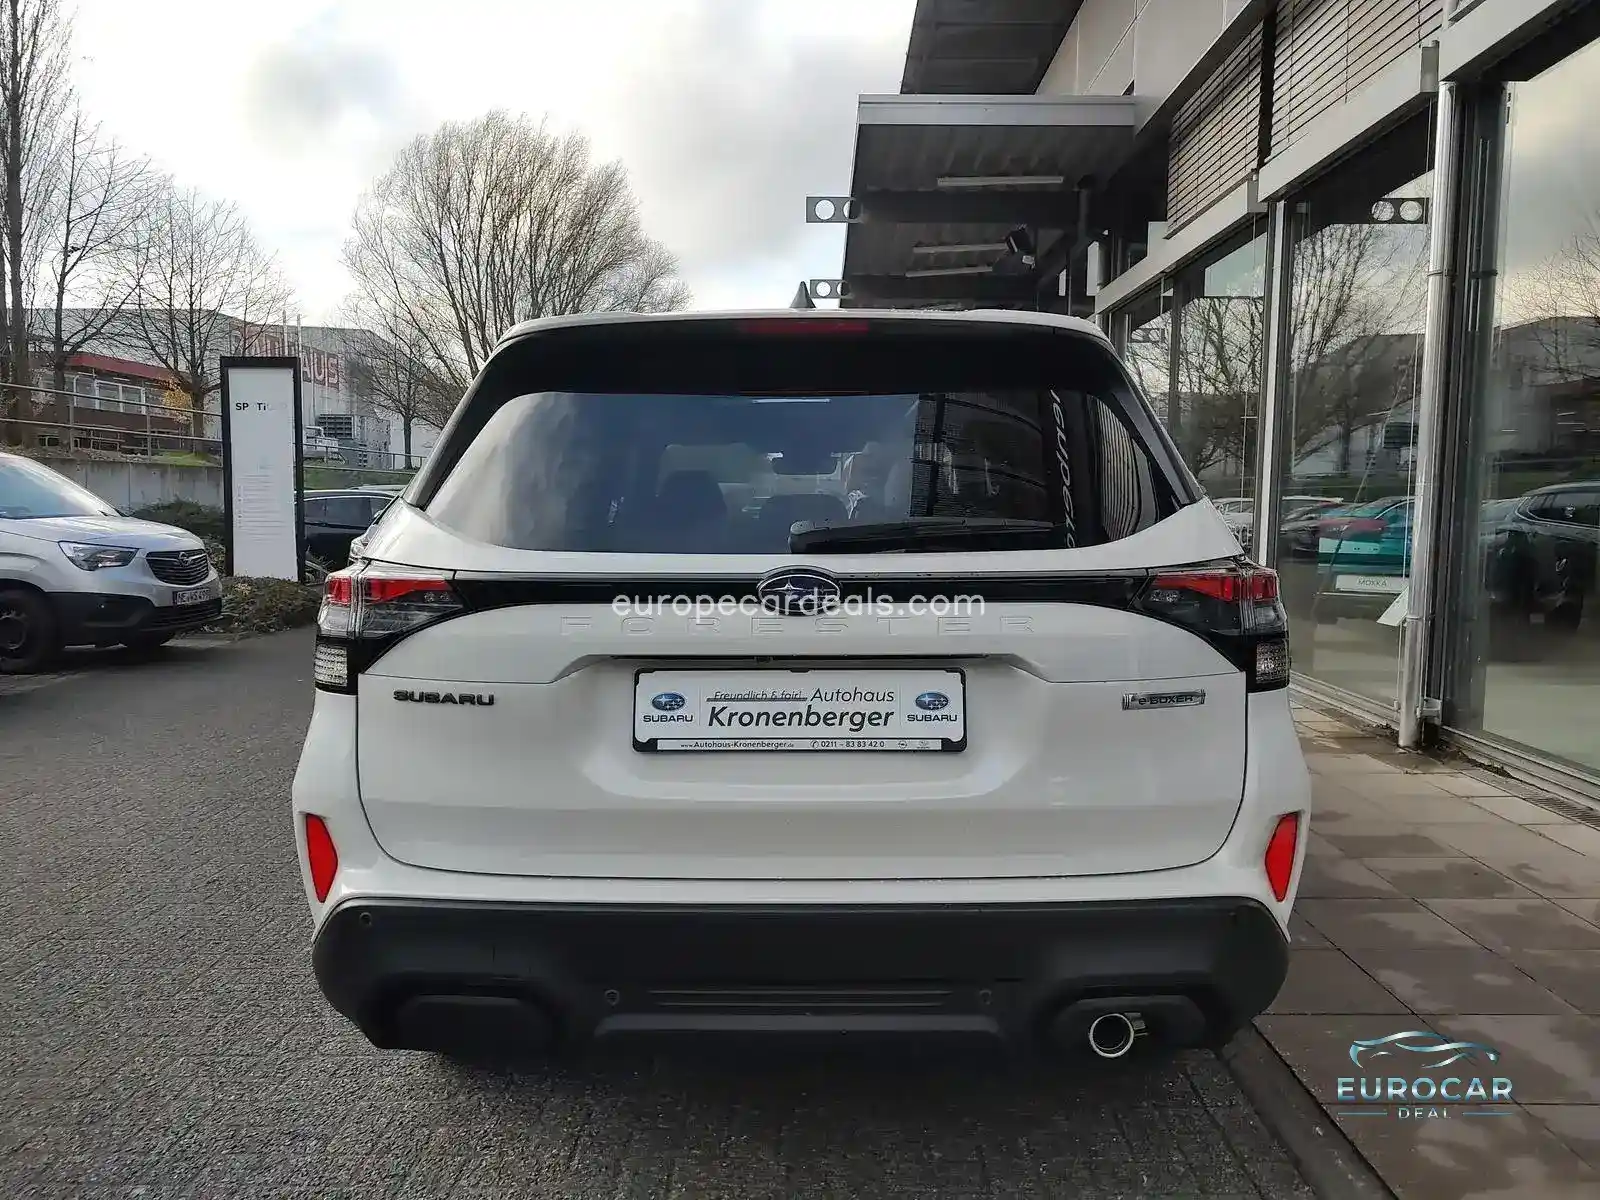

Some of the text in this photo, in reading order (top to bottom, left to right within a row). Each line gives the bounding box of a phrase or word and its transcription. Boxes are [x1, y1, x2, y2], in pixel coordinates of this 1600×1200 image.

[560, 616, 1035, 636] FORESTER
[393, 690, 495, 706] SUBARU
[714, 691, 768, 700] Freundlich
[771, 691, 778, 700] &
[810, 687, 895, 702] Autohaus
[643, 714, 694, 723] SUBARU
[708, 704, 895, 733] Kronenberger
[907, 714, 958, 722] SUBARU
